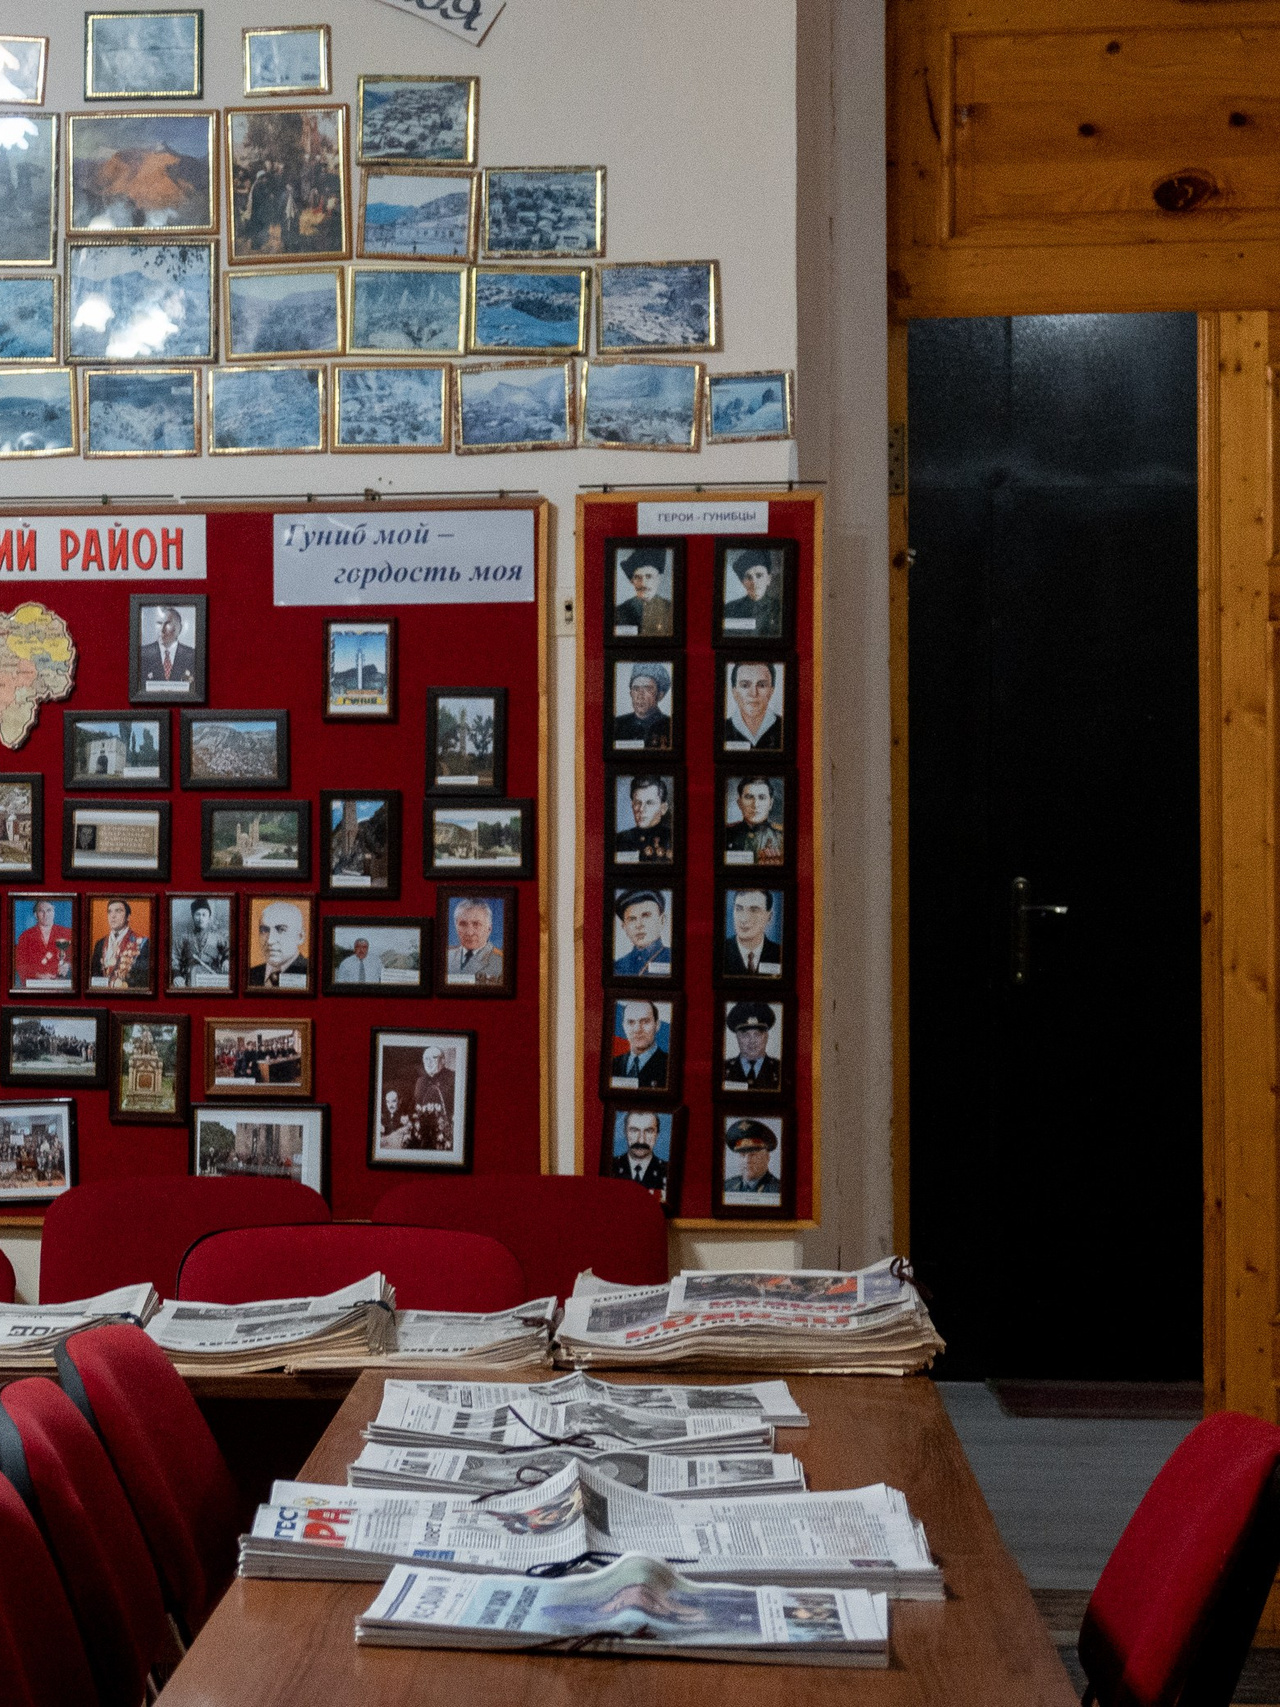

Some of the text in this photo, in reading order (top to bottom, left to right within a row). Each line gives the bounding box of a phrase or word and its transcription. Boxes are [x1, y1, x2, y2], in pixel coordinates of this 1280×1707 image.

[658, 513, 694, 522] ГЕРОИ
[702, 511, 756, 522] ГУНИБЦЫ
[60, 522, 183, 572] РАЙОН
[284, 524, 367, 552] Гуниб
[373, 523, 430, 545] мой
[334, 560, 523, 589] гордость моя
